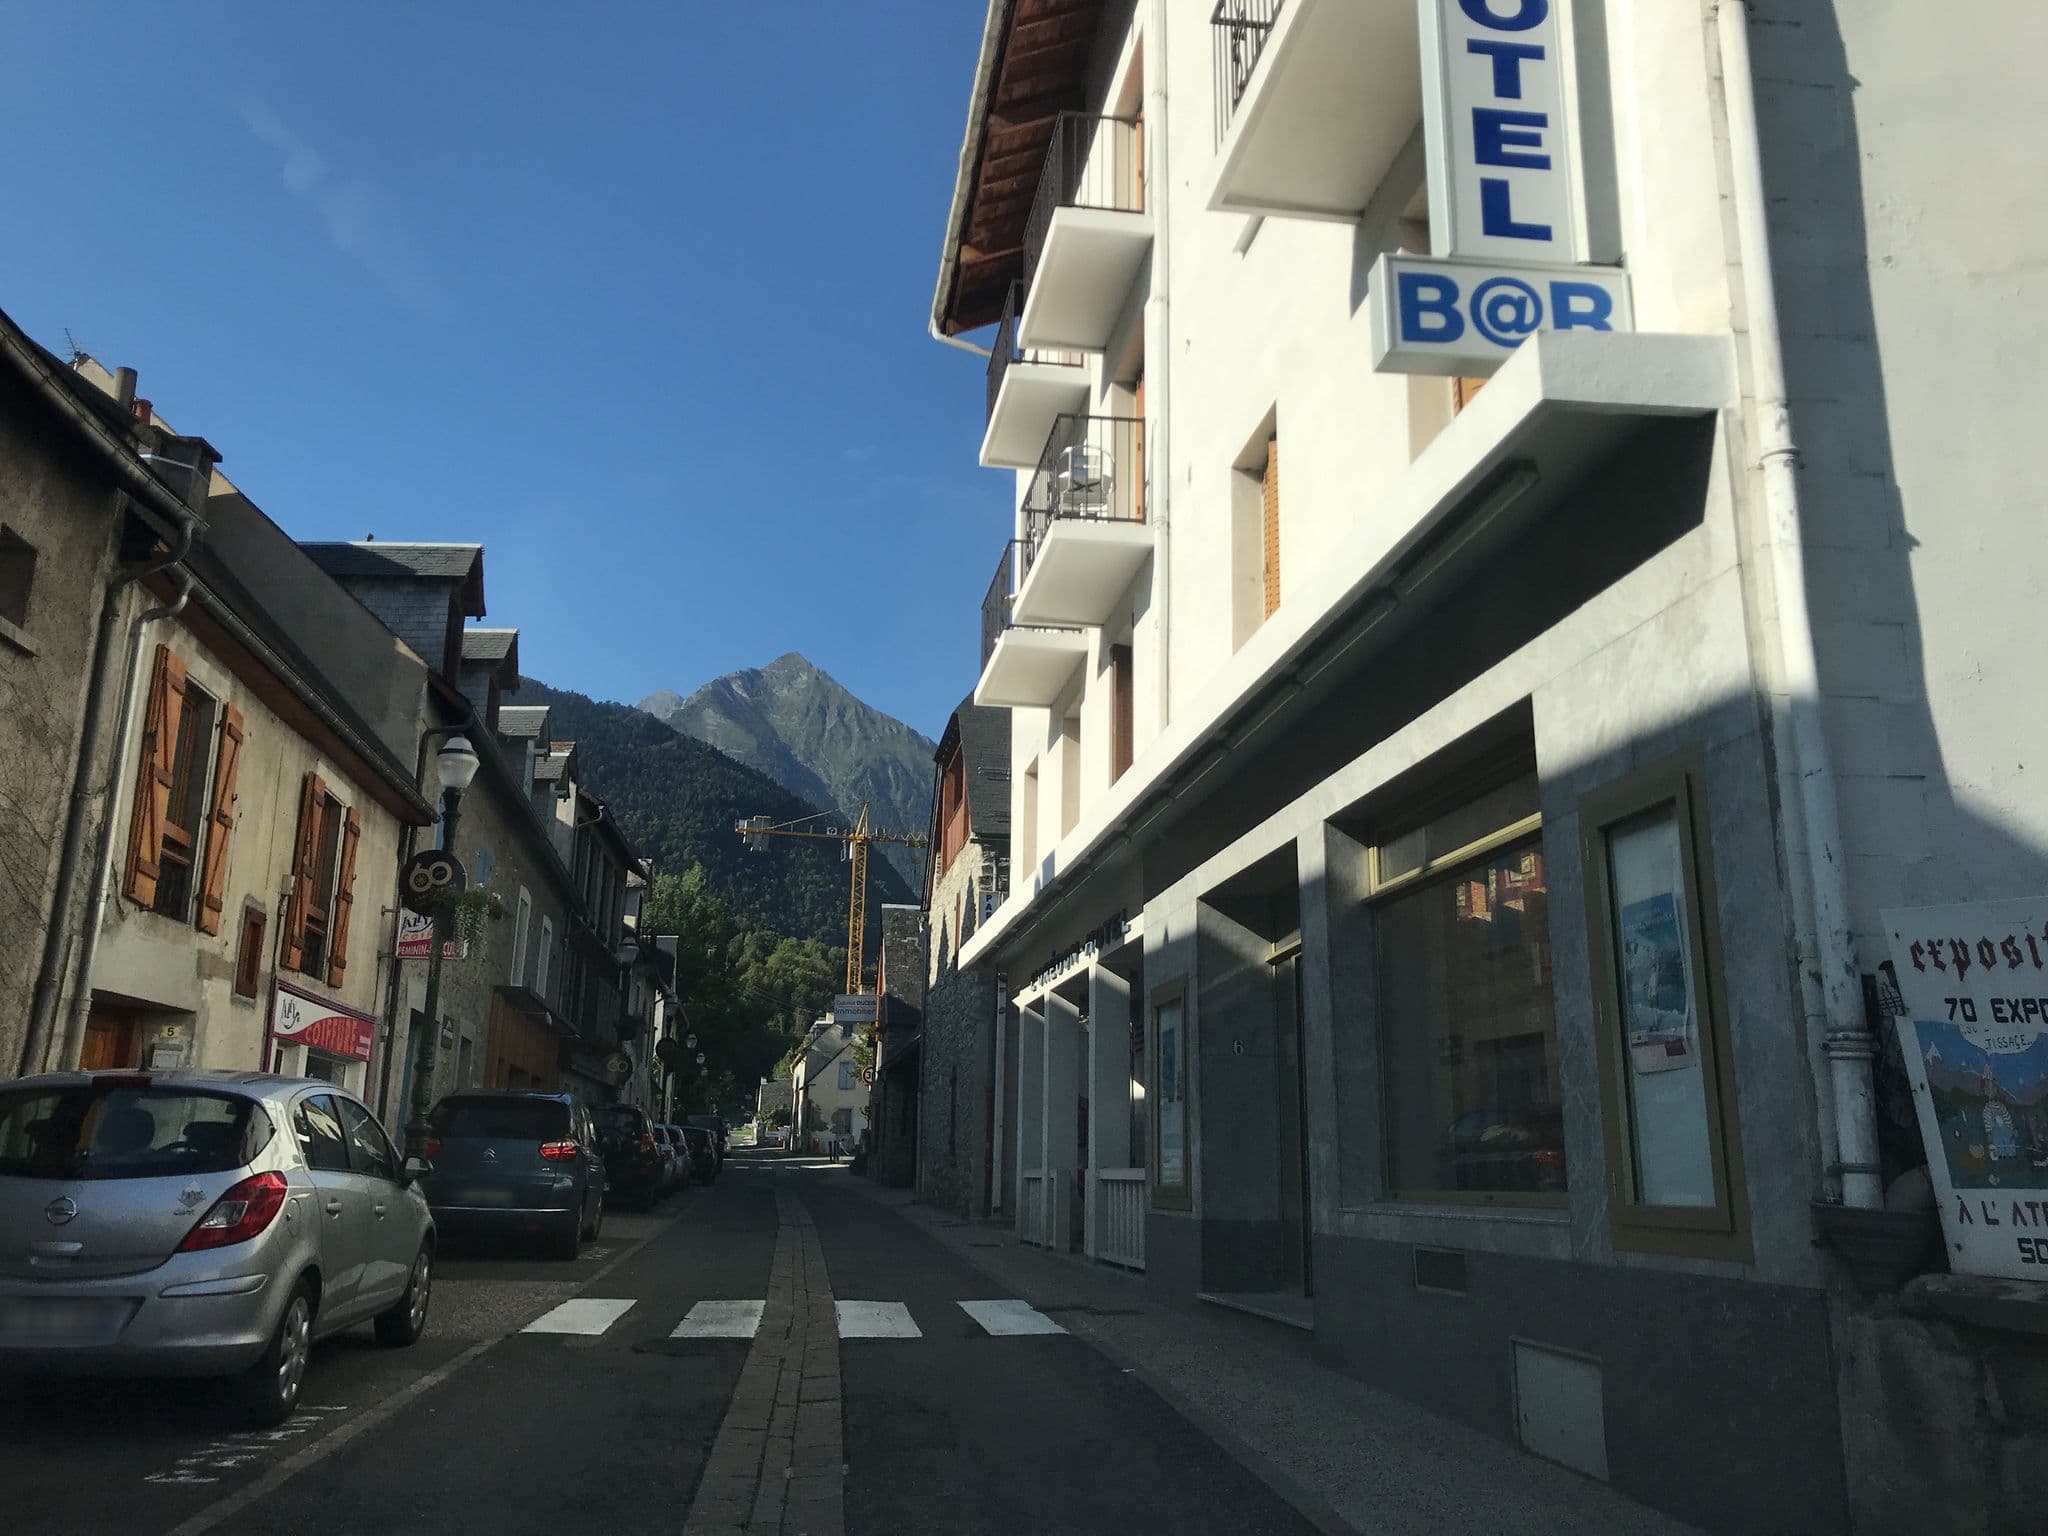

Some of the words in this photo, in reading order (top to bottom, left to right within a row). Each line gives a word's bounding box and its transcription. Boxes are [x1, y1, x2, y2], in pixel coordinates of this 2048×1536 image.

[1944, 997, 1978, 1022] 70
[168, 1027, 175, 1037] 5
[305, 1017, 358, 1055] COIFFURE
[1233, 1040, 1243, 1056] 6
